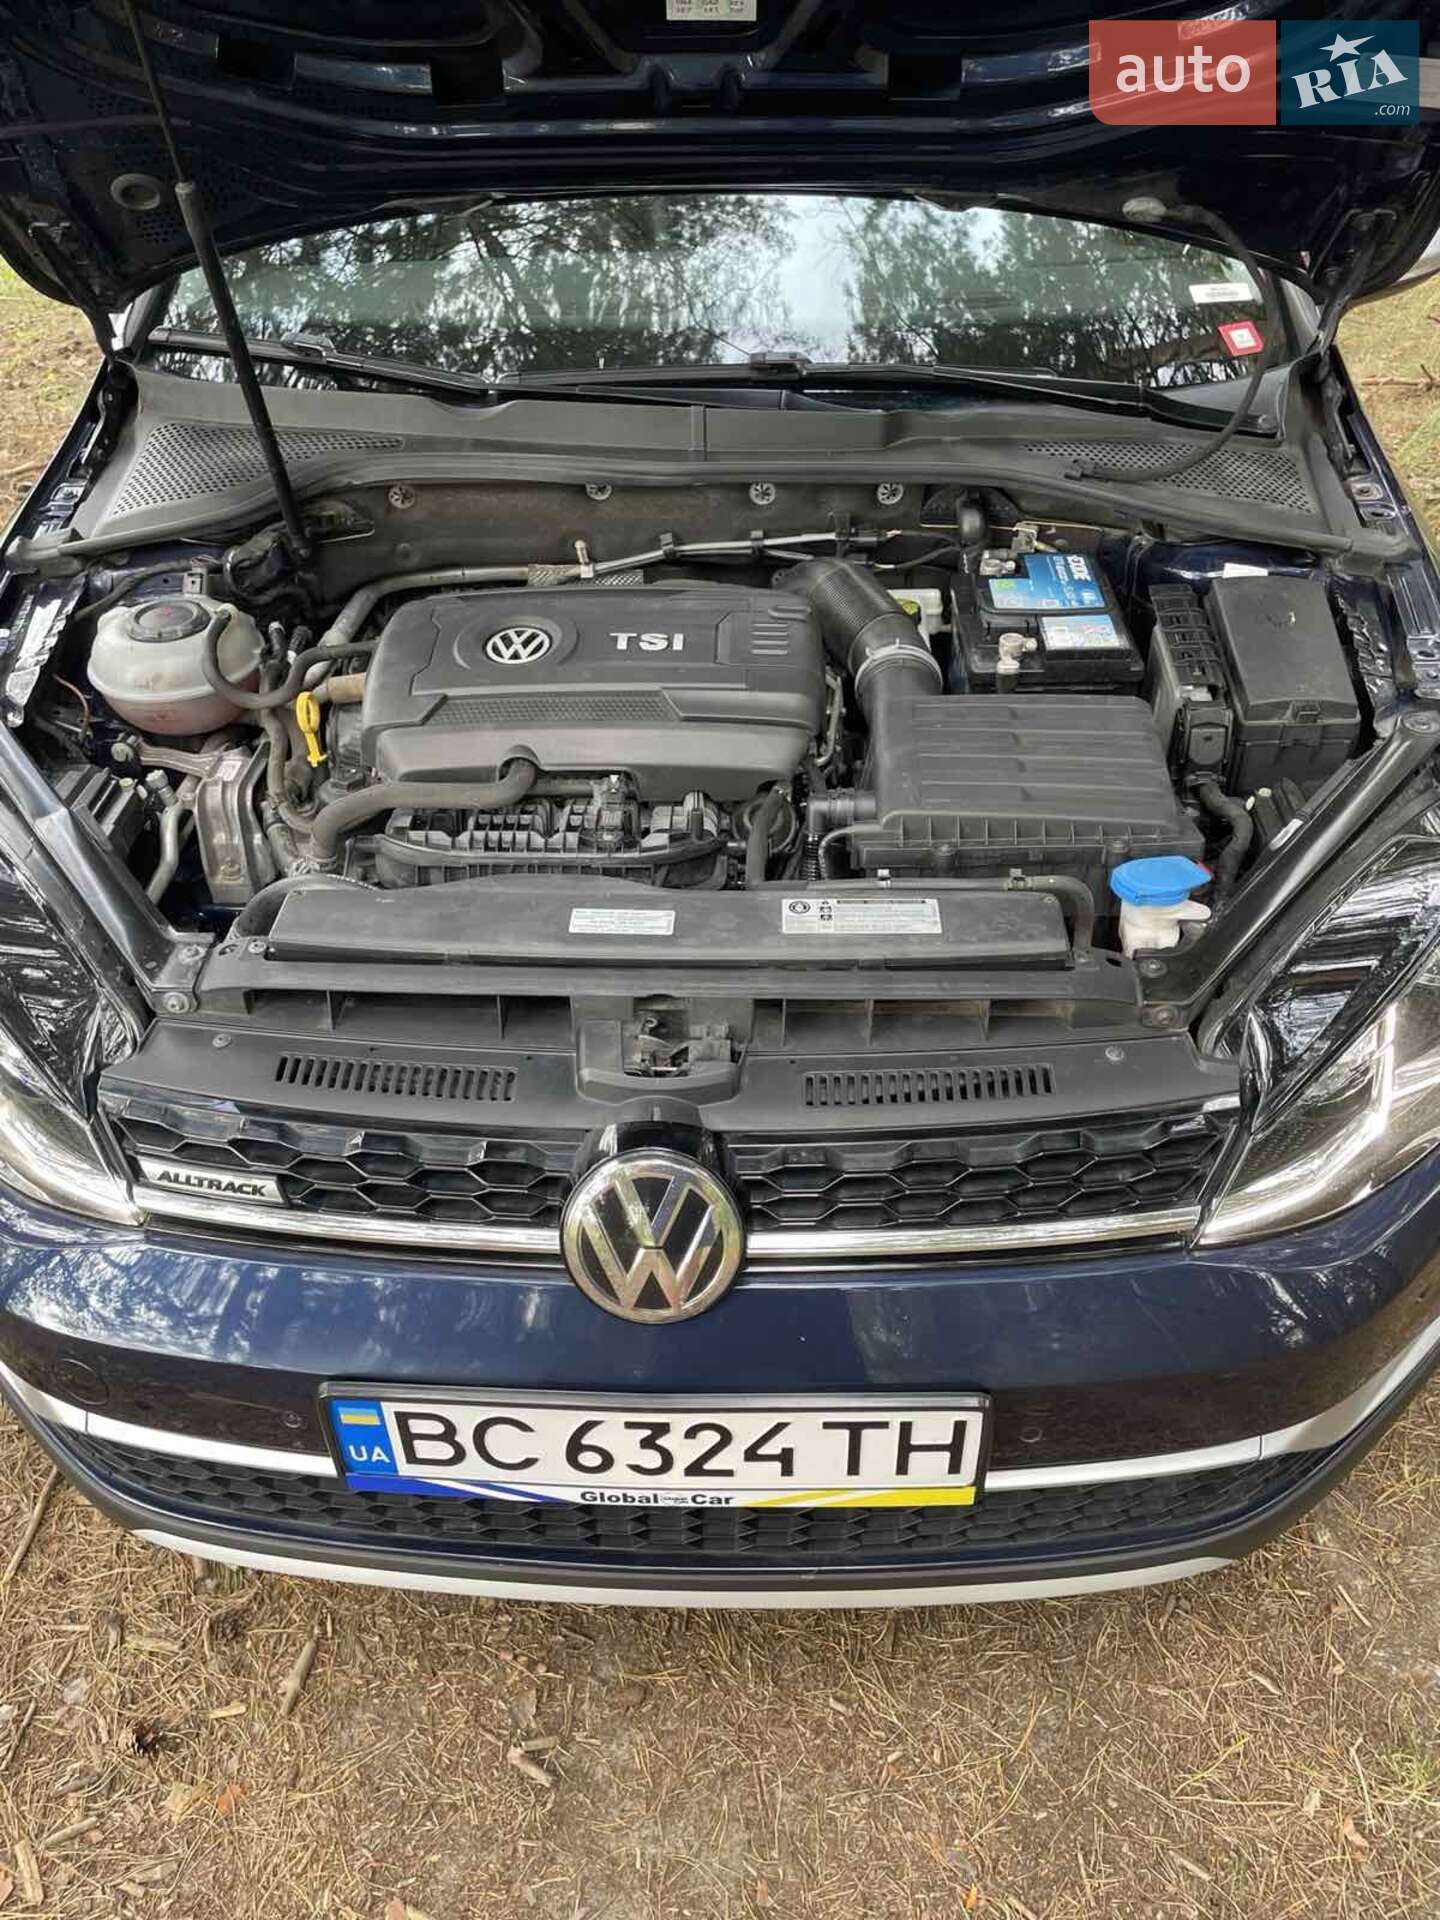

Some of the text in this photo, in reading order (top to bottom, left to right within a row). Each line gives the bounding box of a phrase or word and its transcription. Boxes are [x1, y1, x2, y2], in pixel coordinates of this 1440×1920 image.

[609, 633, 684, 651] TSI
[157, 1170, 267, 1197] ALLTRACK
[394, 1411, 967, 1477] BC 6324 TH
[350, 1445, 390, 1463] UA
[580, 1491, 659, 1505] Global
[691, 1494, 735, 1505] Car
